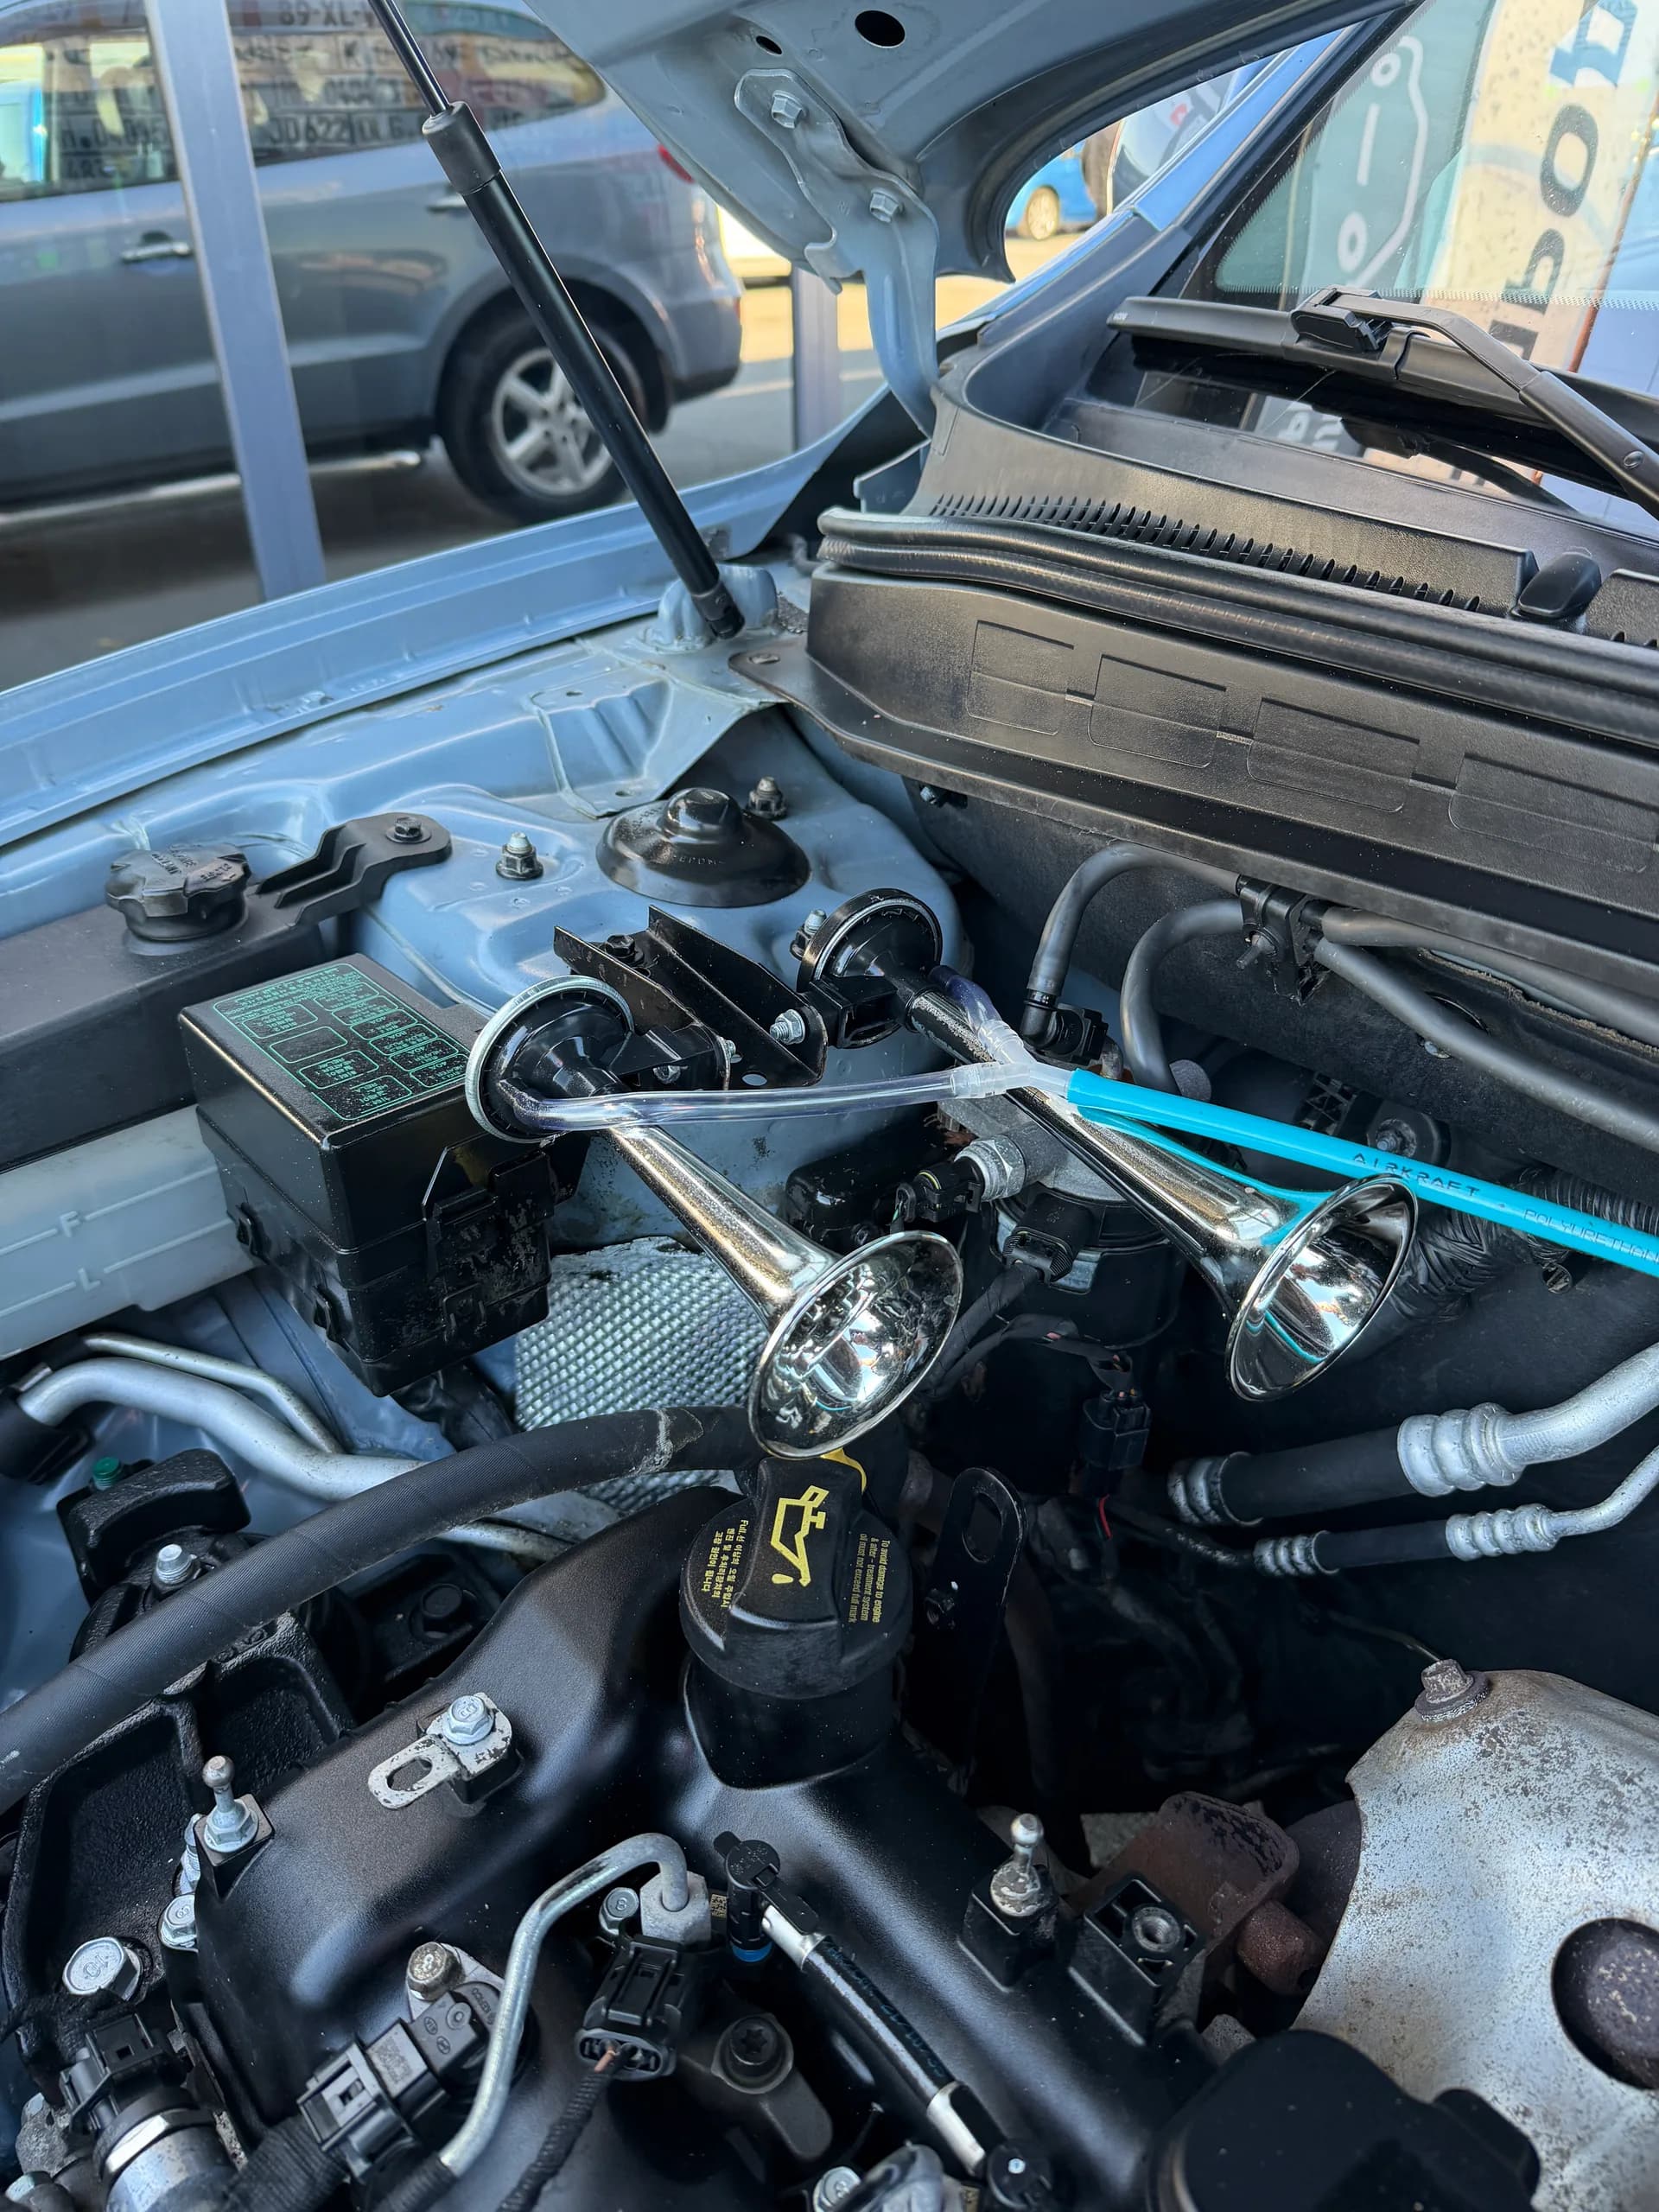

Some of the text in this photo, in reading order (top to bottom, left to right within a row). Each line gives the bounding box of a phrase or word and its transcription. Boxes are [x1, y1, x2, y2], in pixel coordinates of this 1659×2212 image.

[1352, 1152, 1482, 1198] AIRKRAFT
[857, 1541, 866, 1556] must
[879, 1548, 888, 1564] avoid
[727, 1568, 737, 1582] 오일
[853, 1569, 862, 1592] exceed
[864, 1564, 875, 1595] treatment
[876, 1565, 887, 1590] damage
[851, 1594, 860, 1604] full
[861, 1597, 870, 1621] system
[848, 1605, 858, 1624] mark
[872, 1599, 882, 1623] engine
